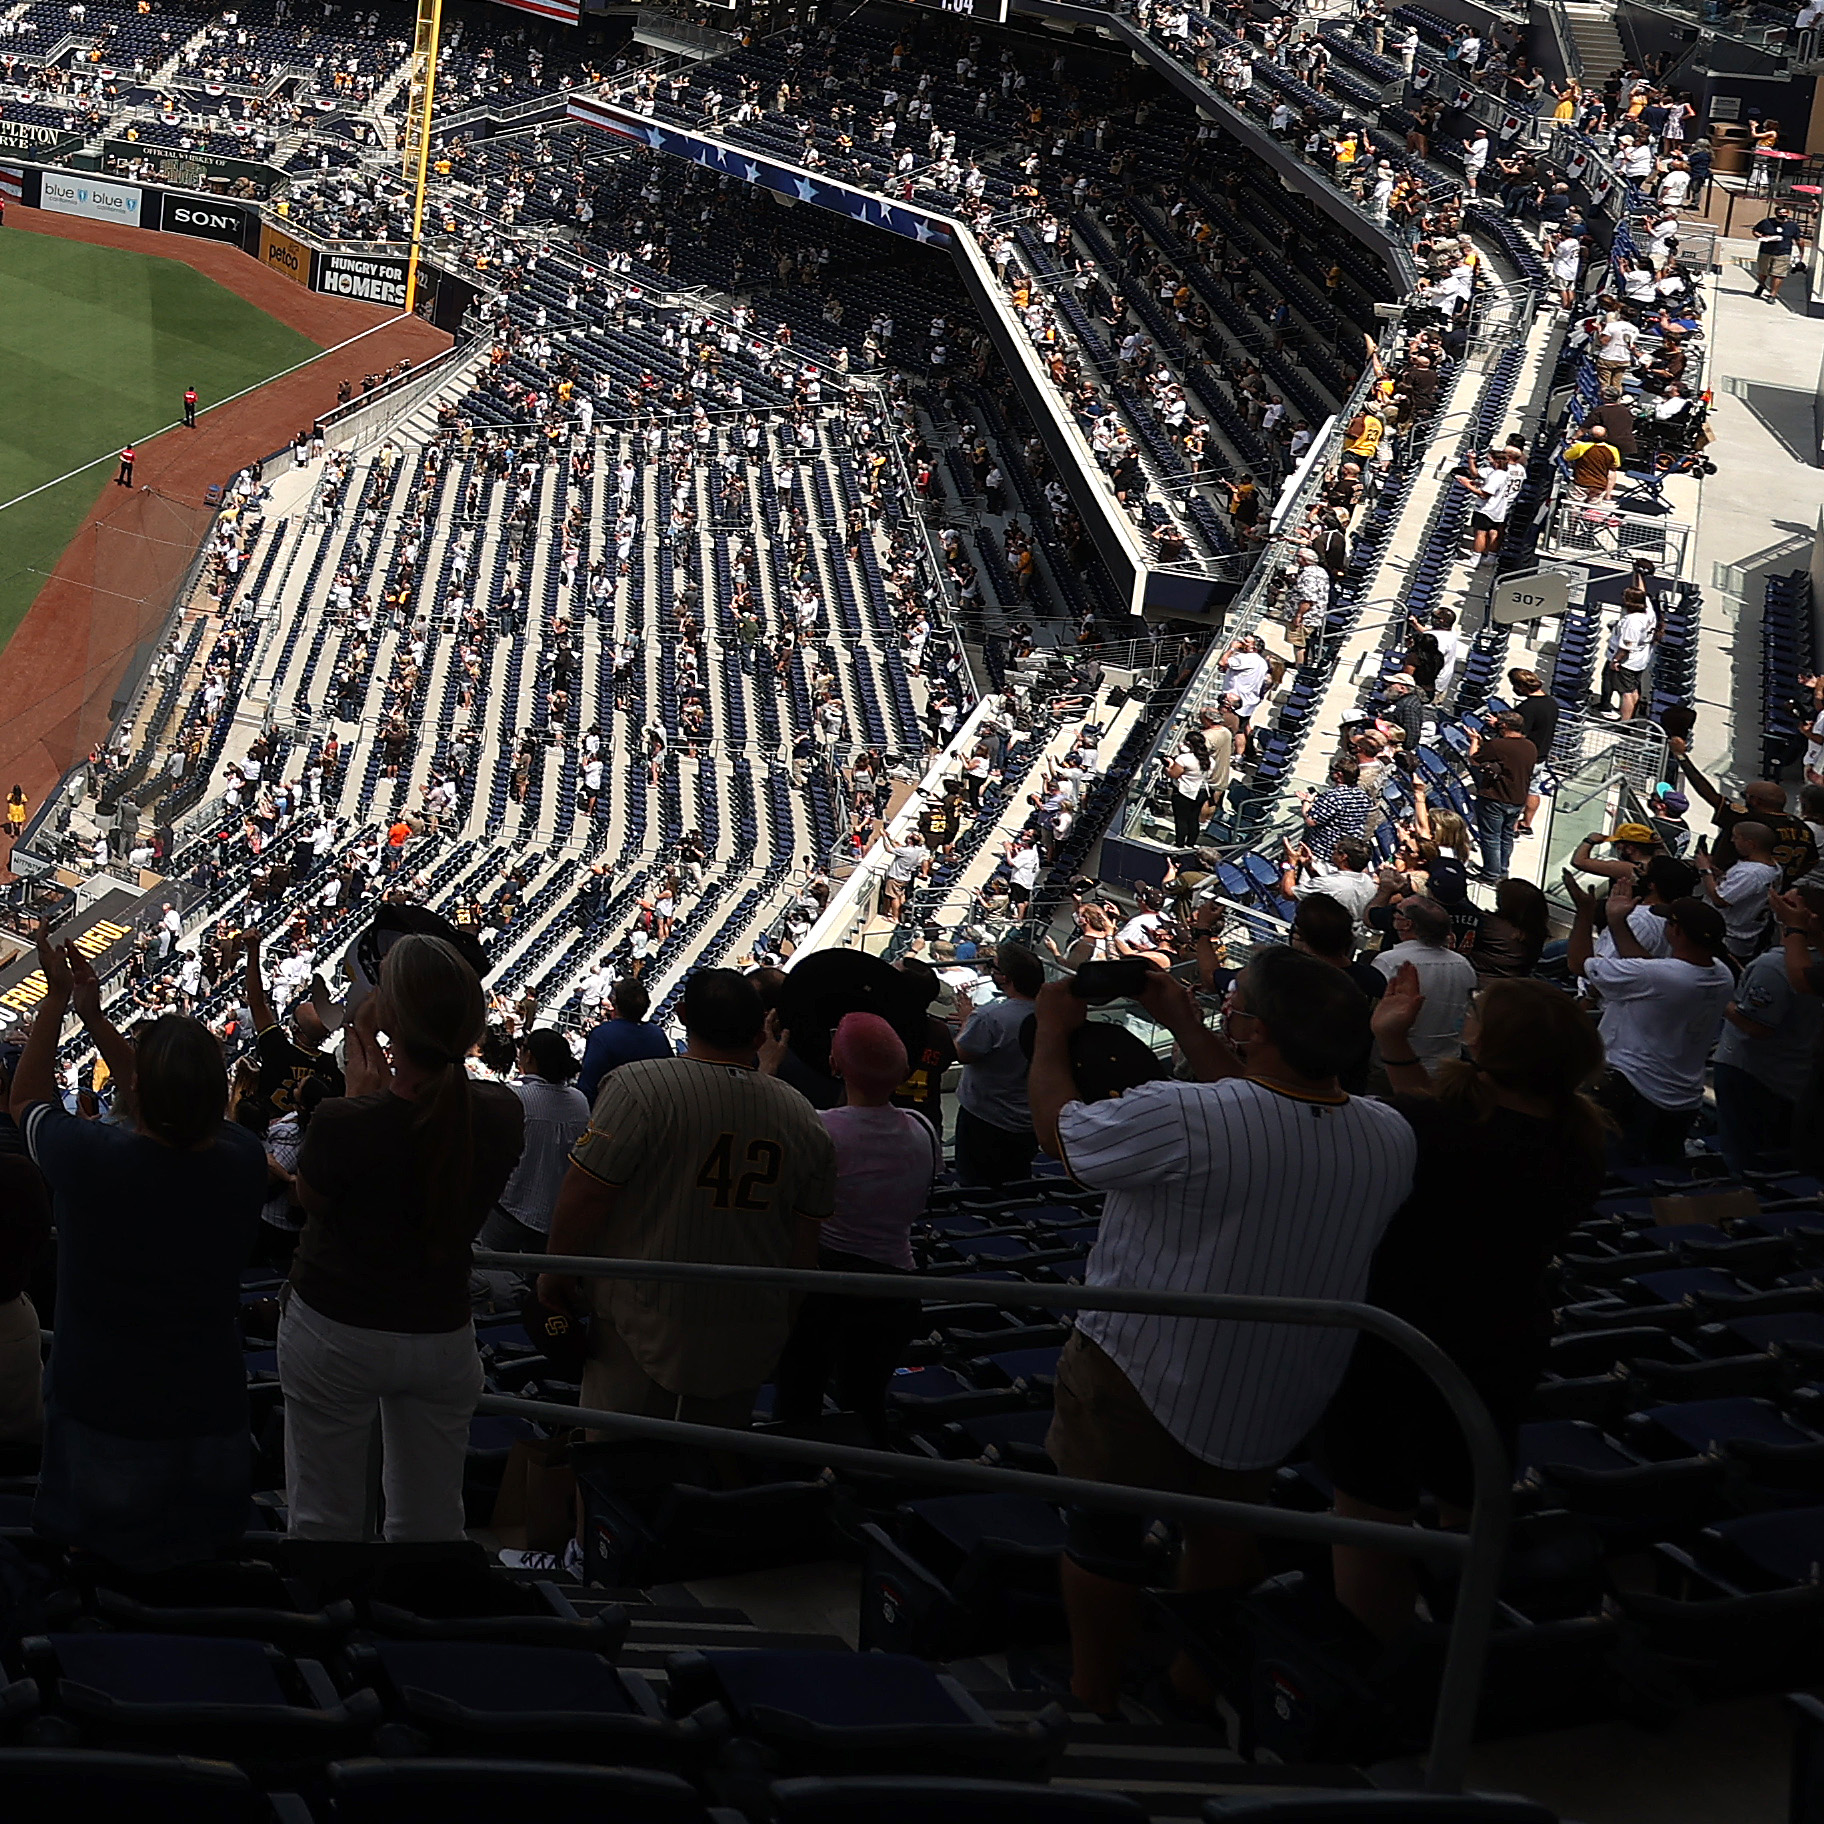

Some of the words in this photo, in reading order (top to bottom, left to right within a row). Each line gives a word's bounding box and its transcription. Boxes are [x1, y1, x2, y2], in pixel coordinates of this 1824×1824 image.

[142, 147, 178, 159] OFFICIAL
[215, 159, 228, 167] OF
[45, 182, 75, 199] blue
[92, 190, 123, 208] blue
[174, 208, 241, 232] SONY
[268, 243, 299, 271] petco
[331, 256, 378, 276] HUNGRY
[380, 265, 402, 281] FOR
[324, 270, 407, 305] HOMERS
[1511, 591, 1545, 608] 307
[696, 1131, 782, 1212] 42
